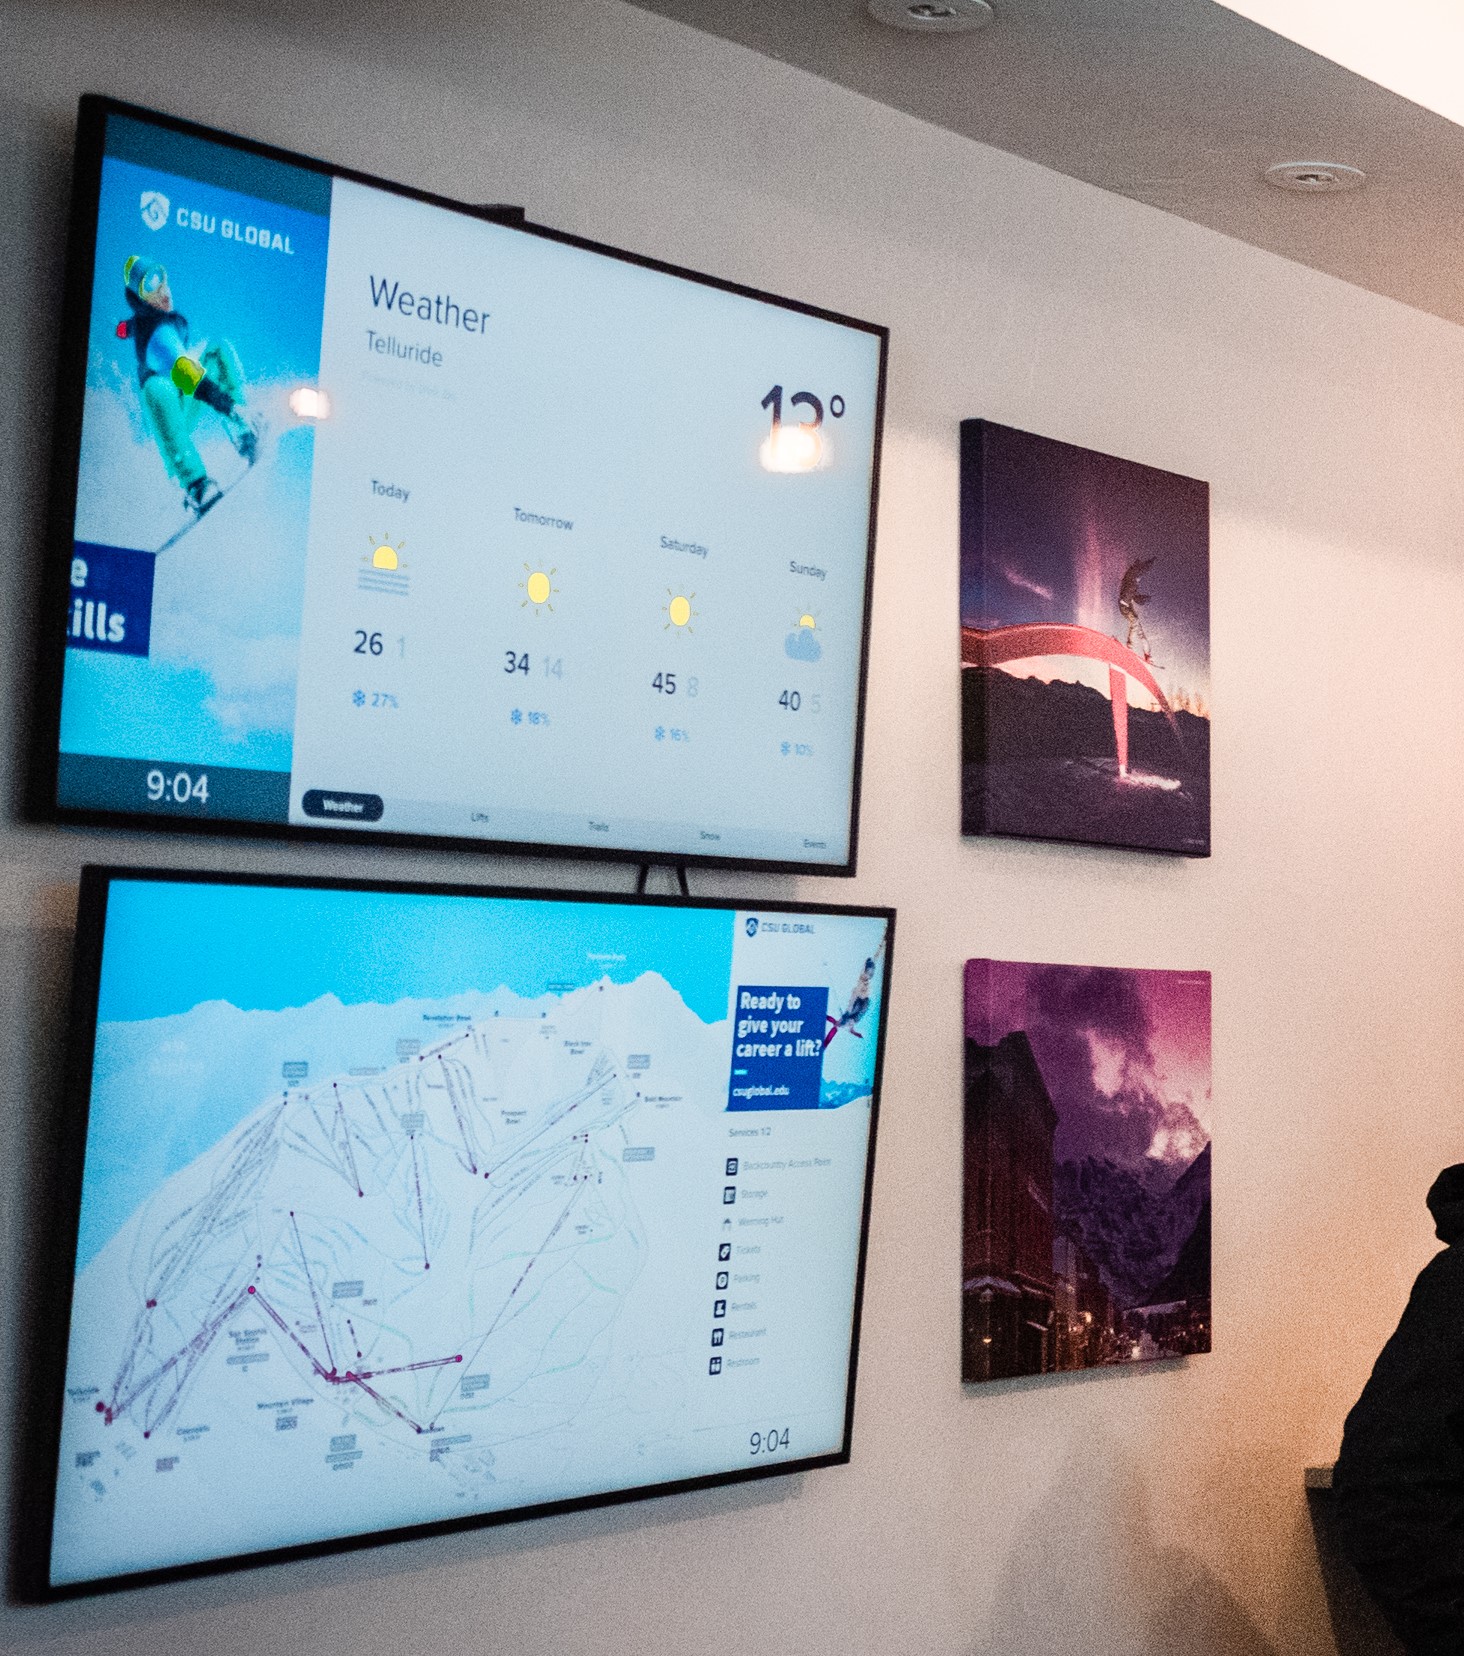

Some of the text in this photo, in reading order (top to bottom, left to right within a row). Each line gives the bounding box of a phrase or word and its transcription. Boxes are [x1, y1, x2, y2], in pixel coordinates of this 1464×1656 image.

[176, 208, 295, 255] CSU GLOBAL
[369, 275, 491, 335] Weather
[365, 331, 444, 368] Telluride
[371, 479, 411, 502] Today
[513, 507, 574, 531] Tomorrow
[660, 535, 709, 559] Saturday
[789, 561, 828, 581] Sunday
[67, 598, 125, 643] ills
[353, 629, 384, 656] 26
[504, 650, 530, 676] 34
[652, 672, 677, 695] 45
[778, 689, 801, 712] 40
[146, 769, 210, 805] 9:04
[322, 798, 364, 816] Weather
[740, 991, 802, 1015] Ready to
[737, 1016, 805, 1039] give your
[736, 1039, 823, 1058] career a lift?
[749, 1427, 790, 1455] 9:04
